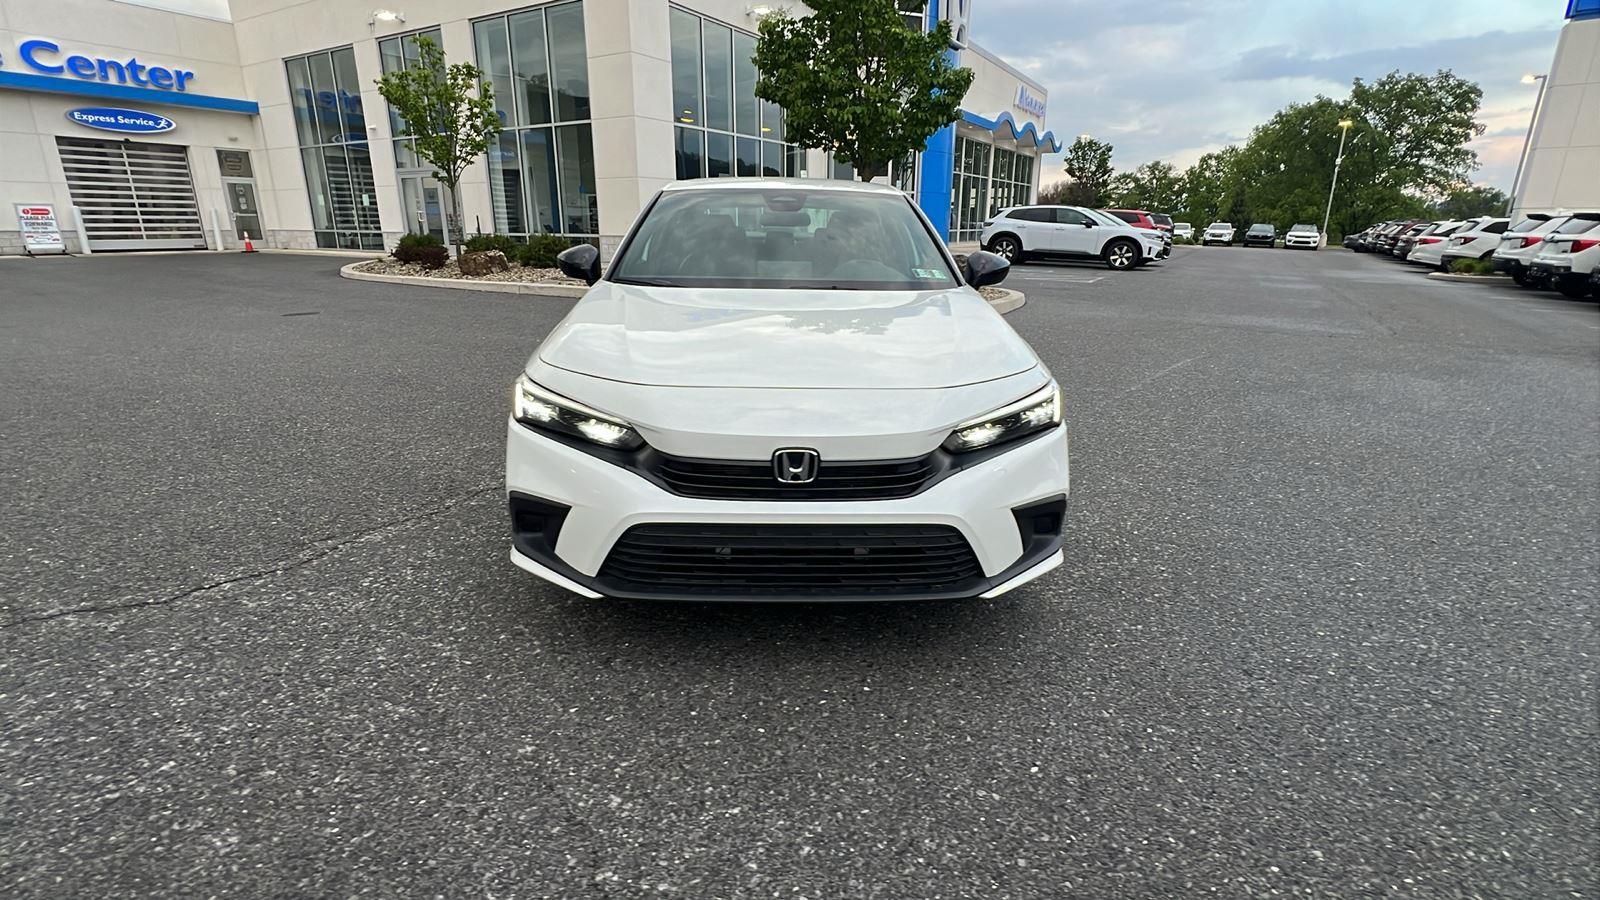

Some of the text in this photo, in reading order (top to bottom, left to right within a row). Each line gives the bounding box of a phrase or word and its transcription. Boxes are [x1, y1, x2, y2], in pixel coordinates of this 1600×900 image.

[19, 40, 194, 91] Center
[73, 111, 155, 126] Express Service
